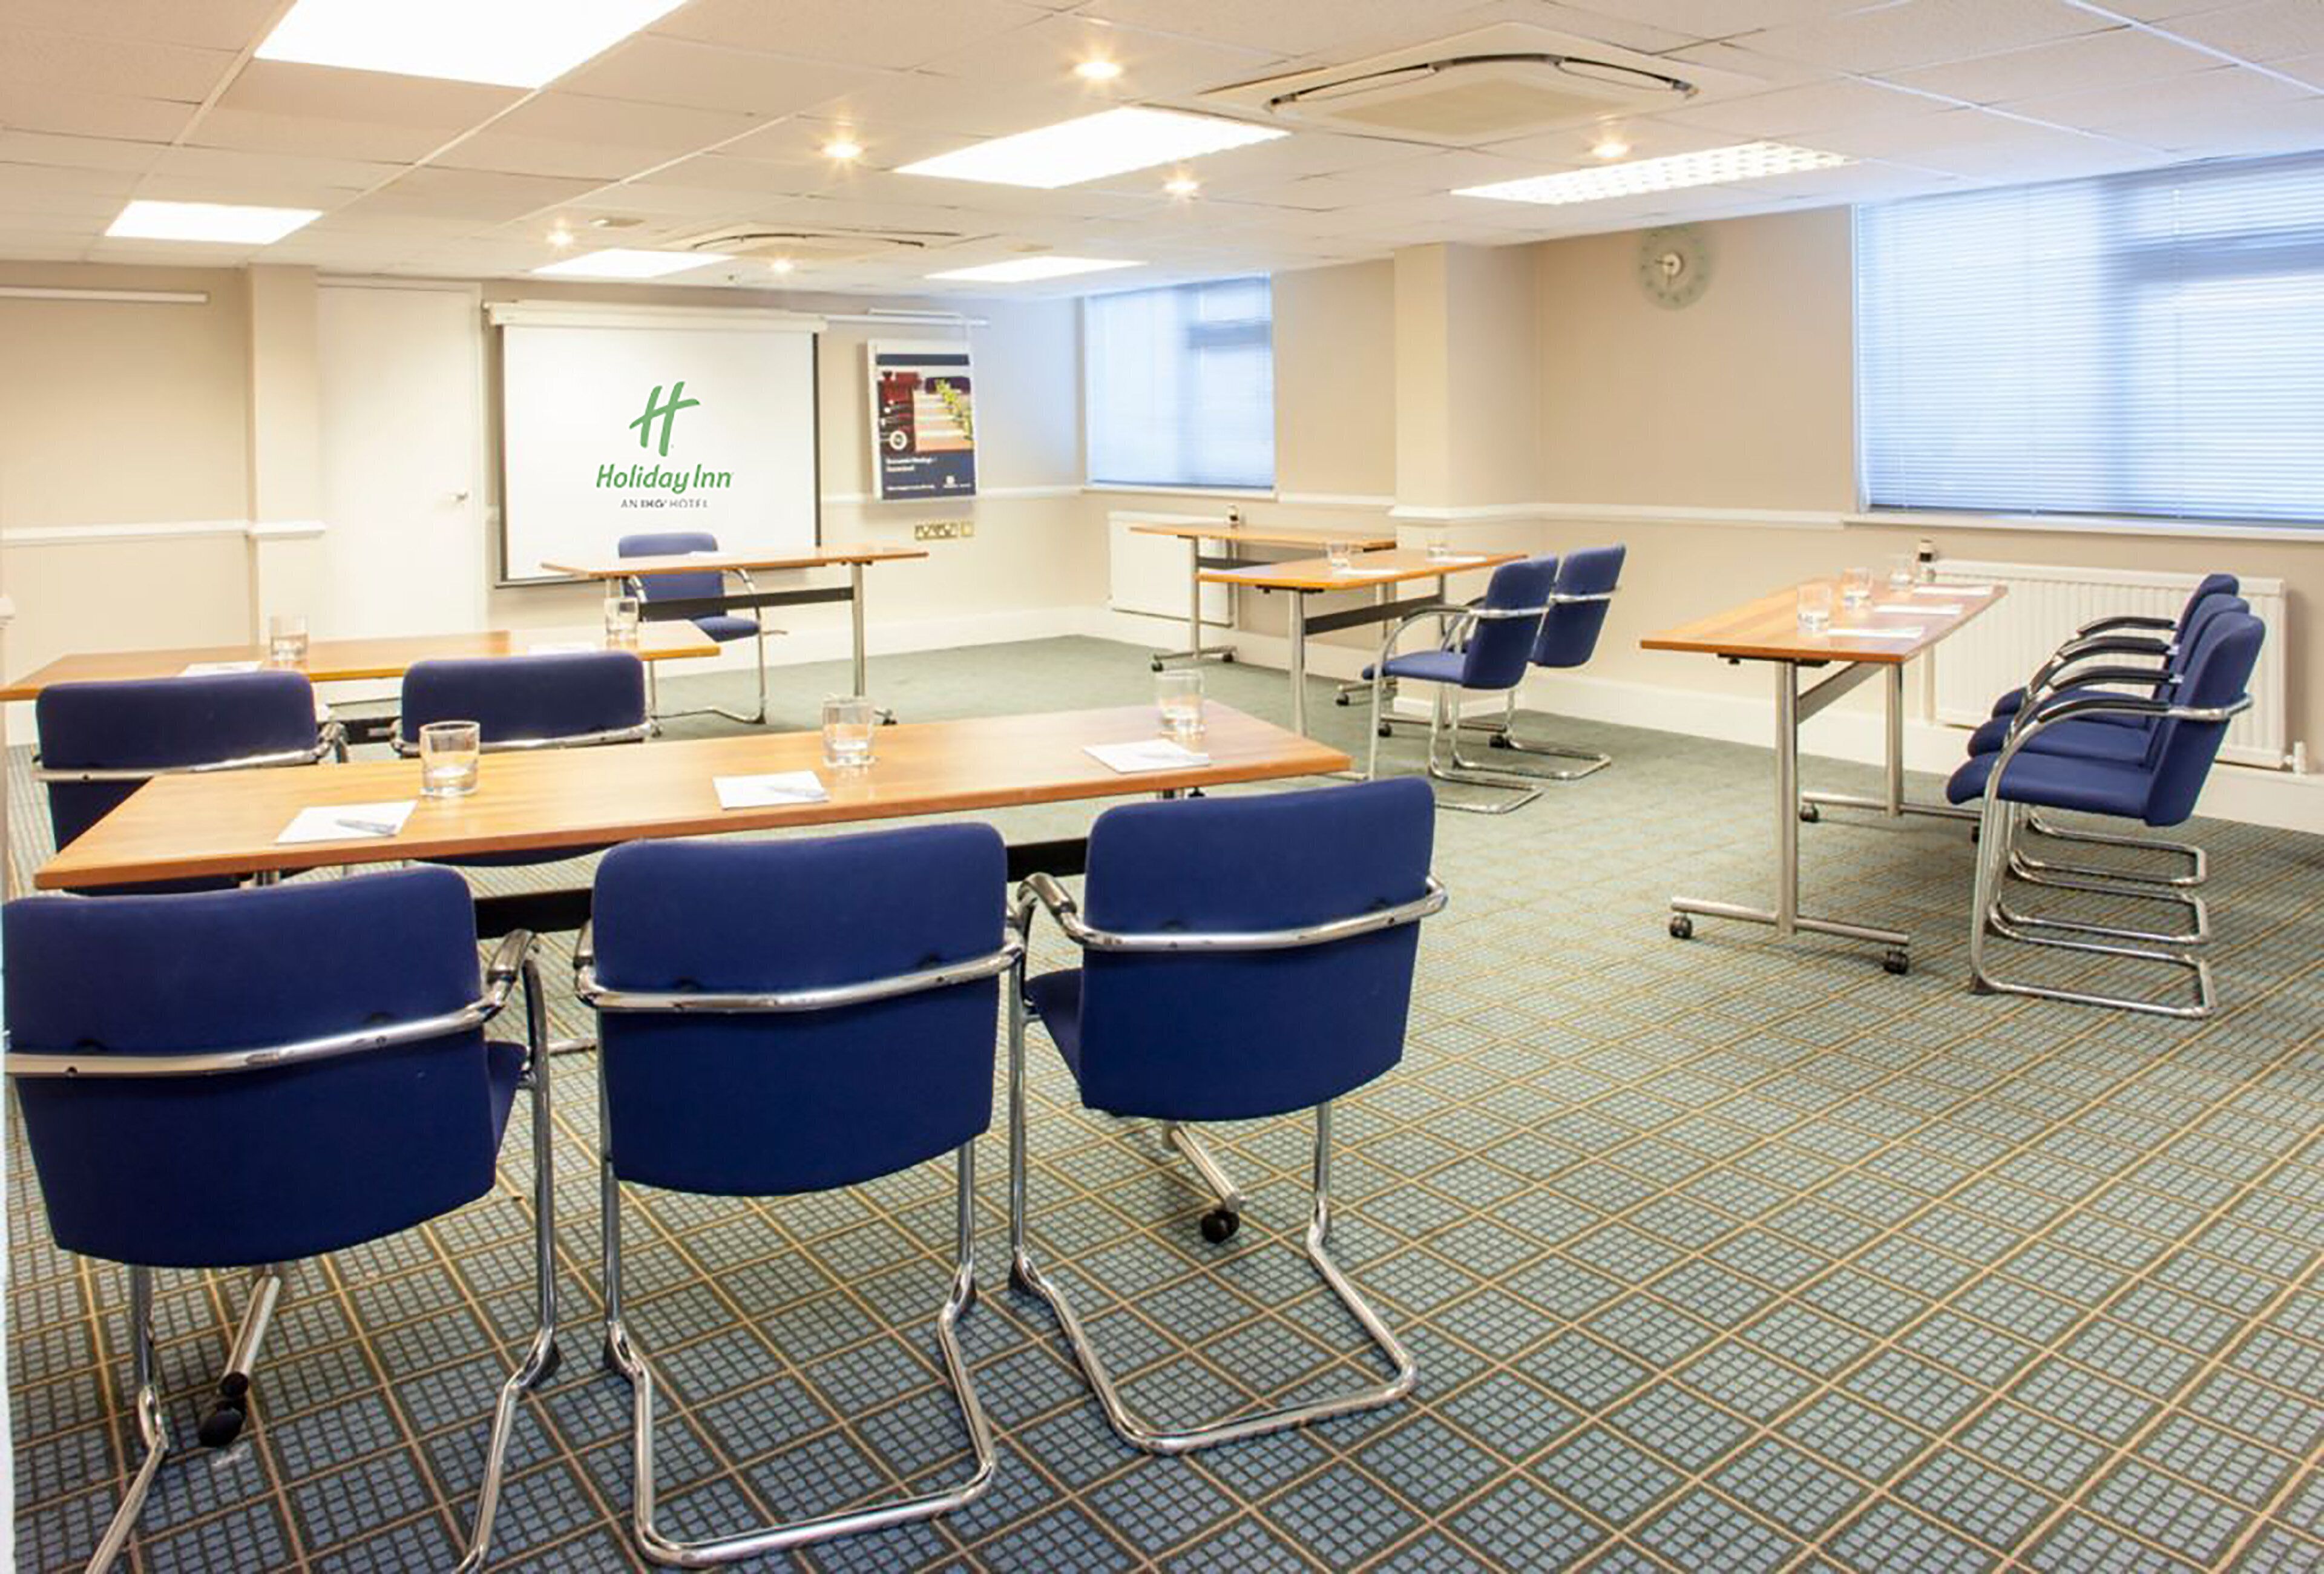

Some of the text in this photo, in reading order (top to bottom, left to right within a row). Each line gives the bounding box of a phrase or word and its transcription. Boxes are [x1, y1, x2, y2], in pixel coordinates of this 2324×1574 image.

[596, 463, 732, 494] Holiday Inn
[620, 498, 638, 508] AN
[669, 498, 707, 508] HOTEL
